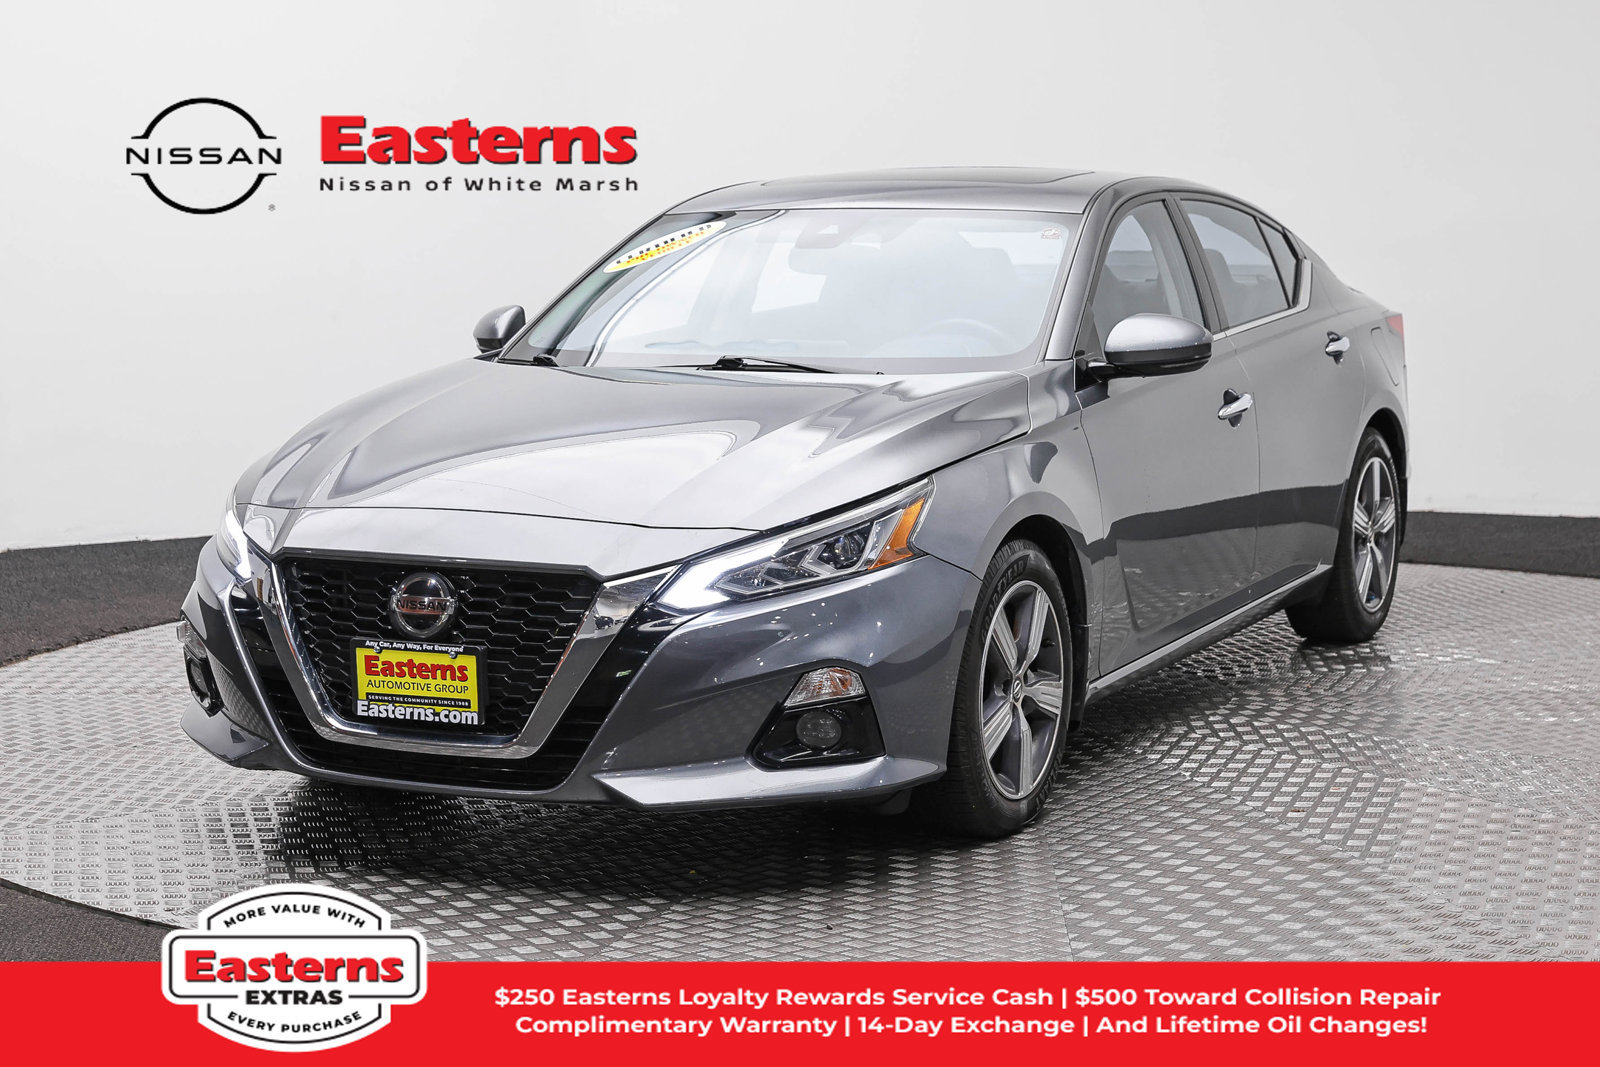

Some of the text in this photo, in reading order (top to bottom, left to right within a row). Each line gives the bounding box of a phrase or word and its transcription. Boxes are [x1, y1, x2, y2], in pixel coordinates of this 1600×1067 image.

[397, 599, 447, 611] NISSAN
[365, 640, 379, 648] Any
[392, 642, 406, 650] Any
[364, 654, 469, 682] Easterns
[366, 679, 469, 694] AUTOMOTIVE GROUP
[357, 699, 479, 725] Easterns.com
